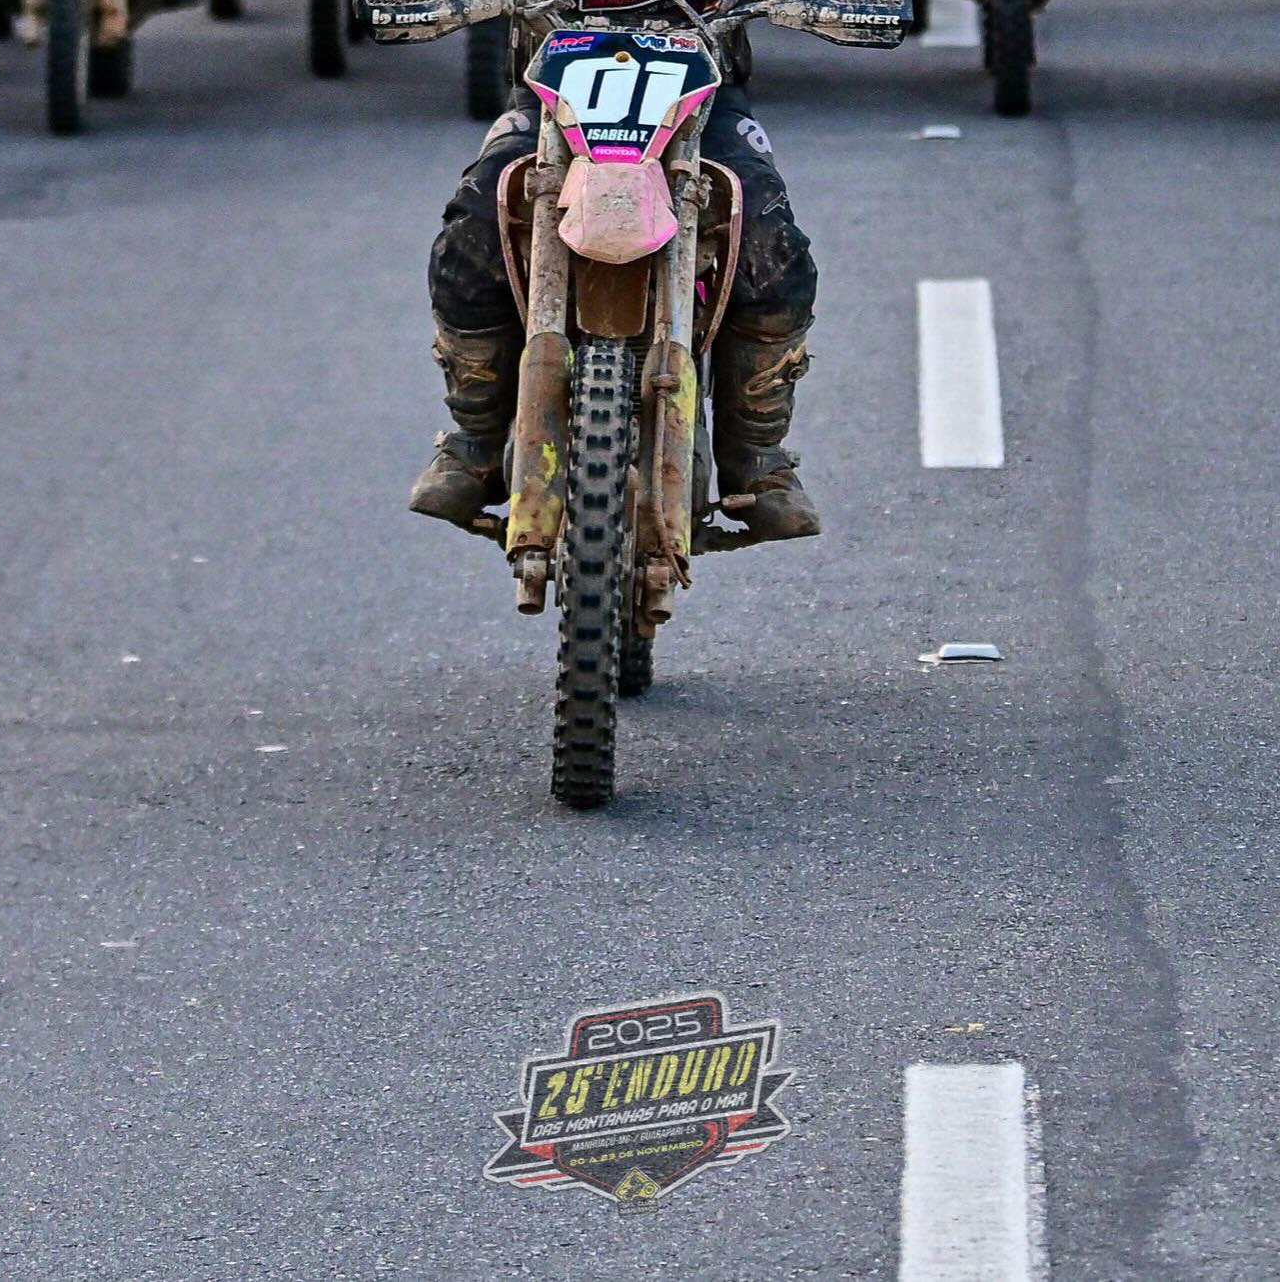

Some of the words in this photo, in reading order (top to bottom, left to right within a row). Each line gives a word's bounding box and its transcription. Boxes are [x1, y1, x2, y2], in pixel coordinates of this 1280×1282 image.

[842, 13, 900, 25] BIKER
[559, 57, 688, 126] 01
[587, 128, 637, 142] ISABELA
[595, 148, 638, 156] HONDA
